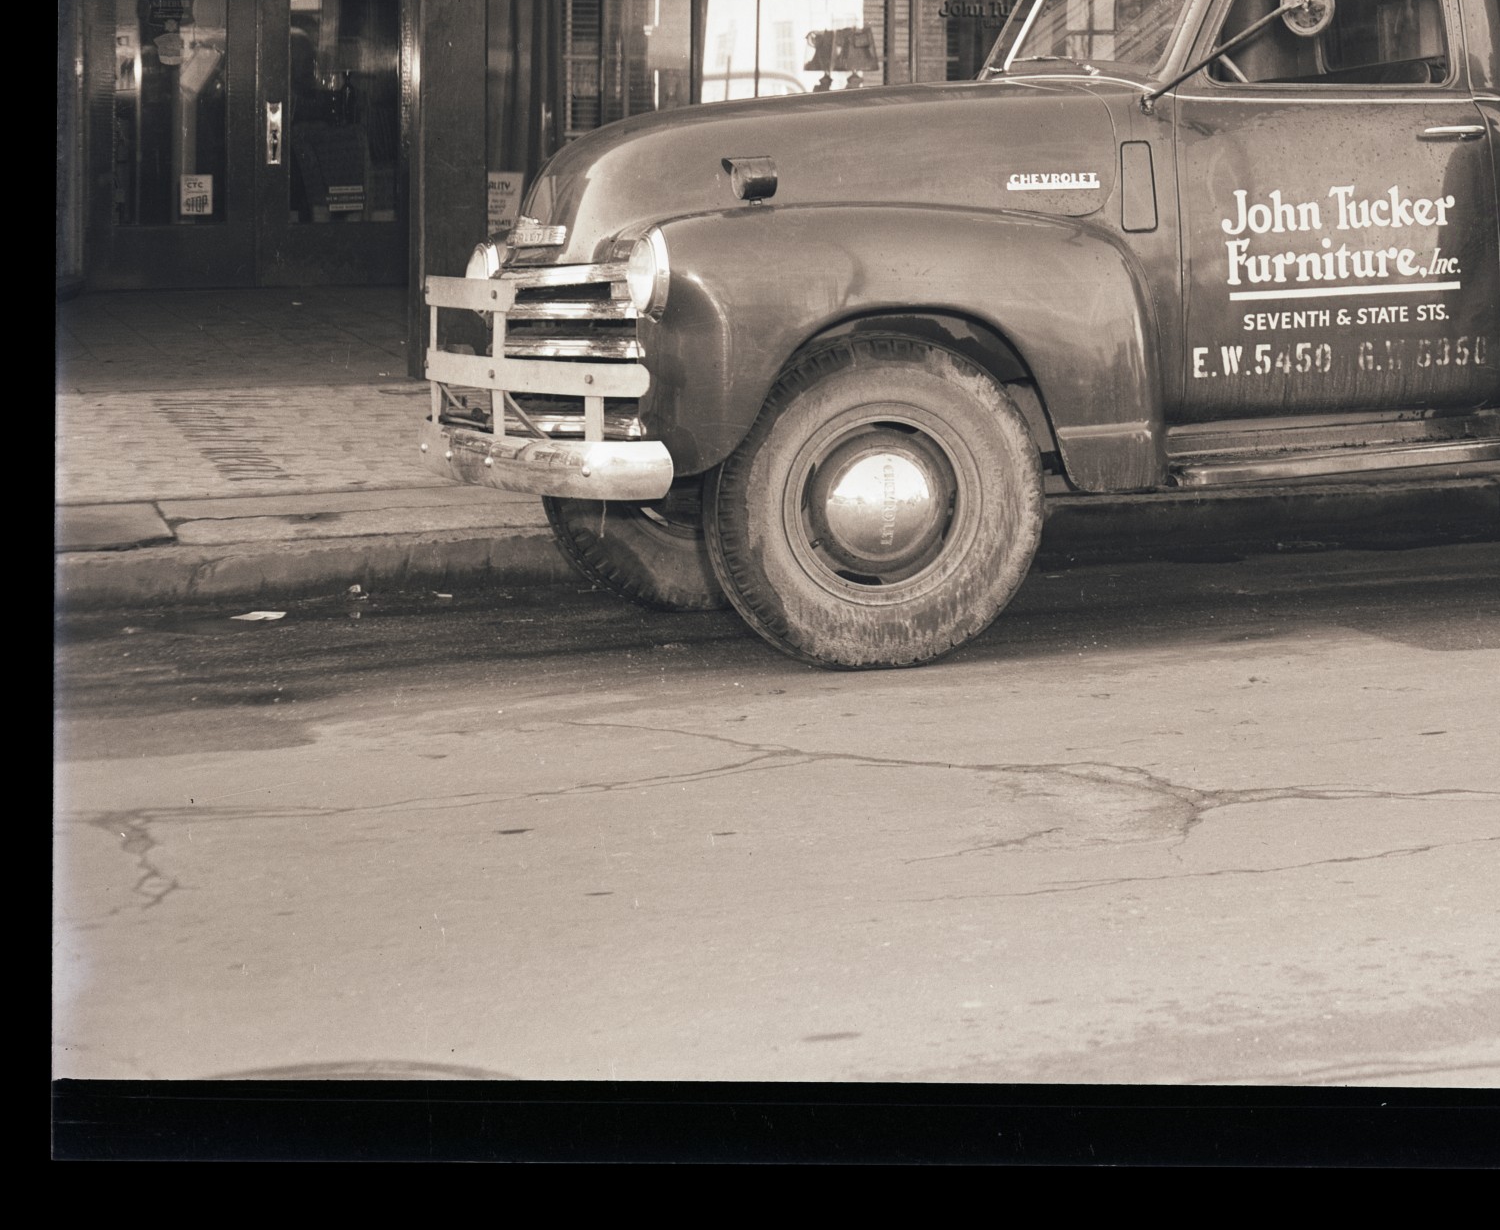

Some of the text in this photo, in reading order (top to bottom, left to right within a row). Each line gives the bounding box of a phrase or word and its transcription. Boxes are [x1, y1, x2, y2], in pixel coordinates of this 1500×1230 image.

[938, 0, 986, 18] John
[1009, 172, 1098, 185] CHEVROLET
[185, 194, 208, 213] STOP
[1221, 185, 1456, 235] John Tucker
[1428, 247, 1462, 276] Inc.
[1243, 304, 1450, 331] SEVENTH & STATE STS.
[880, 464, 897, 546] CHEVROLET
